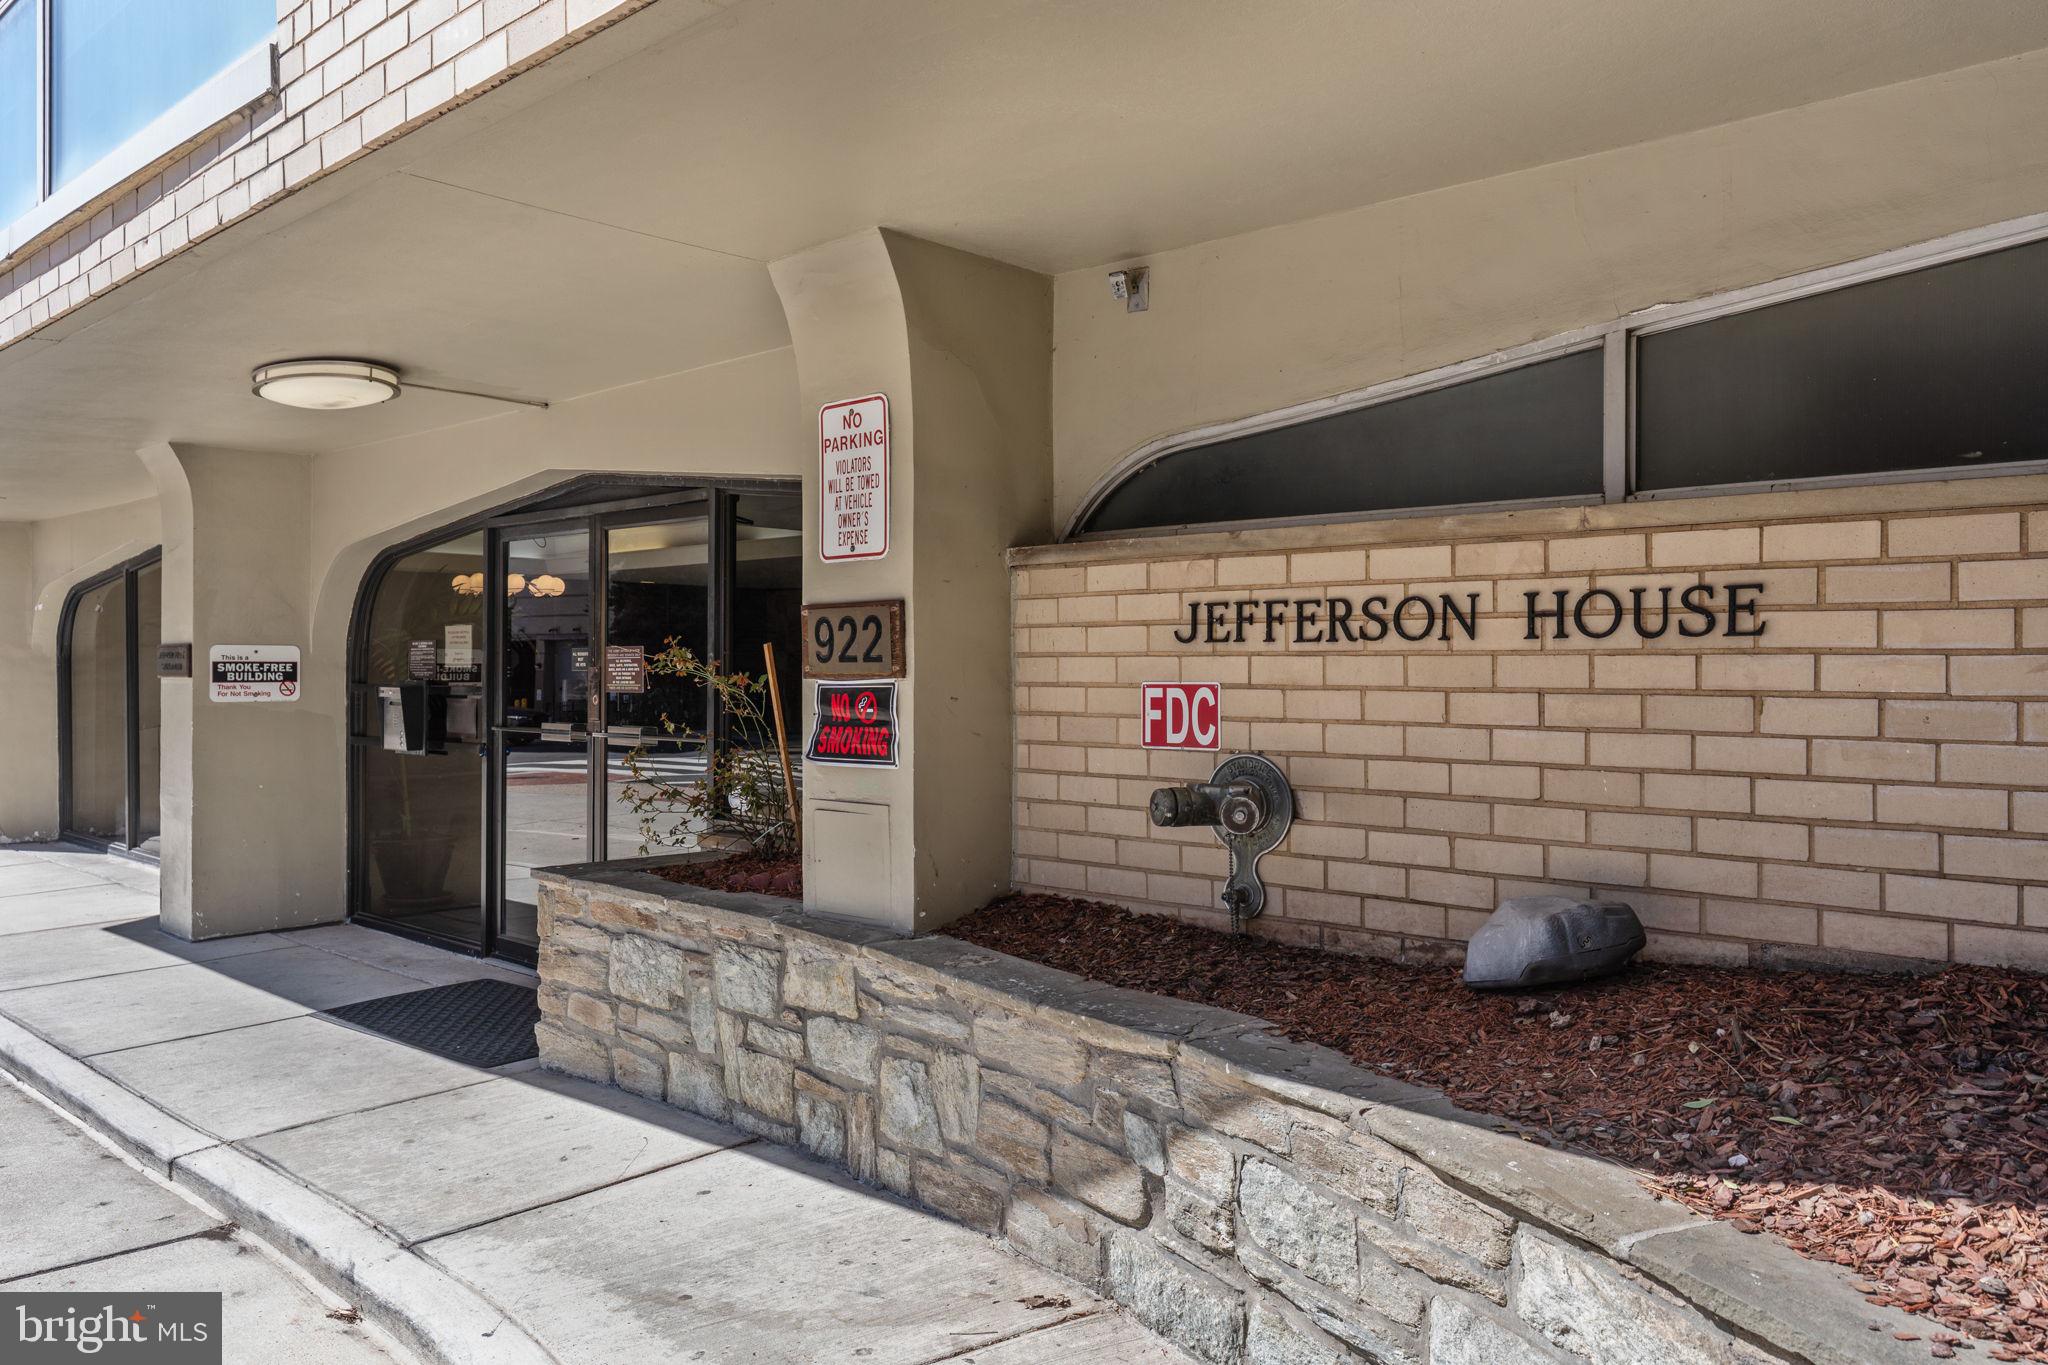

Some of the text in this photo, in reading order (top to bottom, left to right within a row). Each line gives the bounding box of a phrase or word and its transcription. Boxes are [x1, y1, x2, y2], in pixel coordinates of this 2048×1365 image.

[843, 412, 862, 430] NO
[824, 429, 884, 453] PARKING
[835, 456, 872, 476] VIOLATORS
[828, 473, 880, 494] WILL BE TOWED
[834, 492, 873, 511] AT VEHICLE
[837, 511, 869, 529] OWNER'S
[838, 529, 869, 547] EXPENSE
[1174, 583, 1767, 644] JEFFERSON HOUSE
[814, 615, 883, 664] 922
[217, 663, 293, 672] SMOKE-FREE
[226, 672, 284, 681] BUILDING
[831, 693, 850, 722] NO
[1144, 686, 1216, 746] FDC
[817, 726, 889, 756] SMOKING
